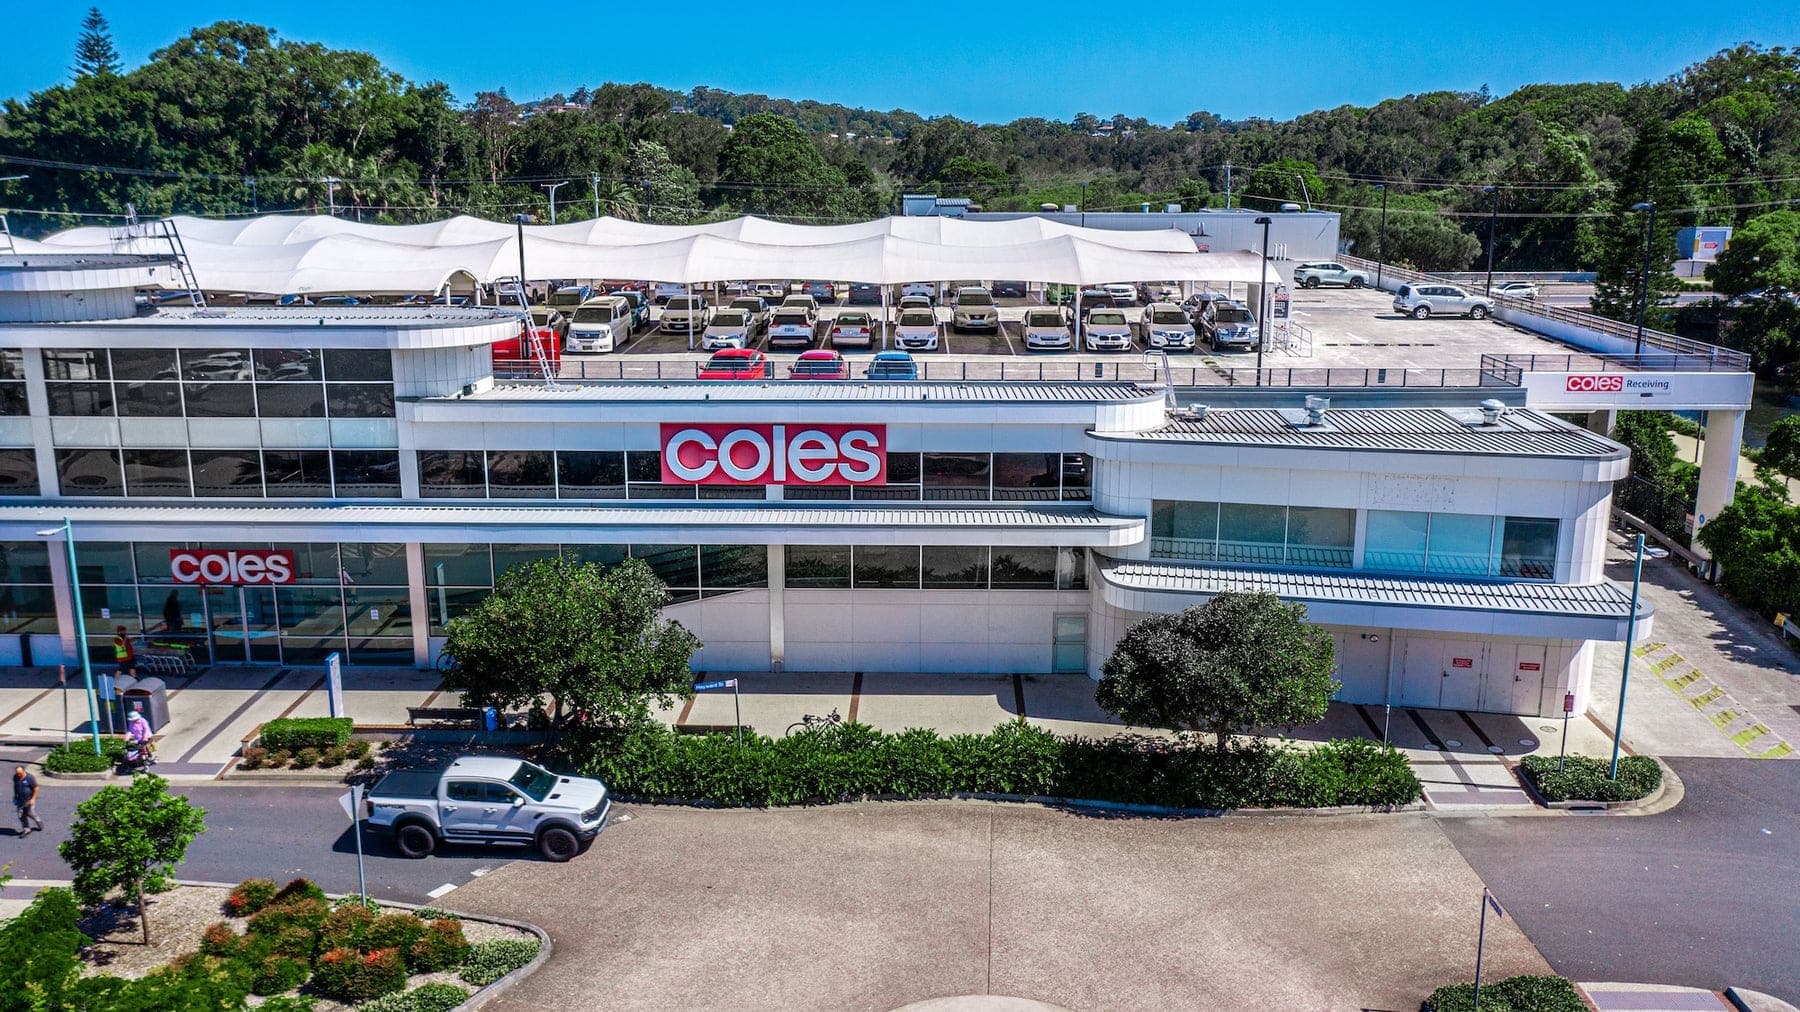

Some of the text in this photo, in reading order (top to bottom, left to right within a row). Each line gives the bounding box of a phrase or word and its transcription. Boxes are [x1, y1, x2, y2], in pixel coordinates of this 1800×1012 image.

[1567, 375, 1669, 391] coles Receiving
[665, 425, 881, 483] coles
[171, 551, 291, 583] coles
